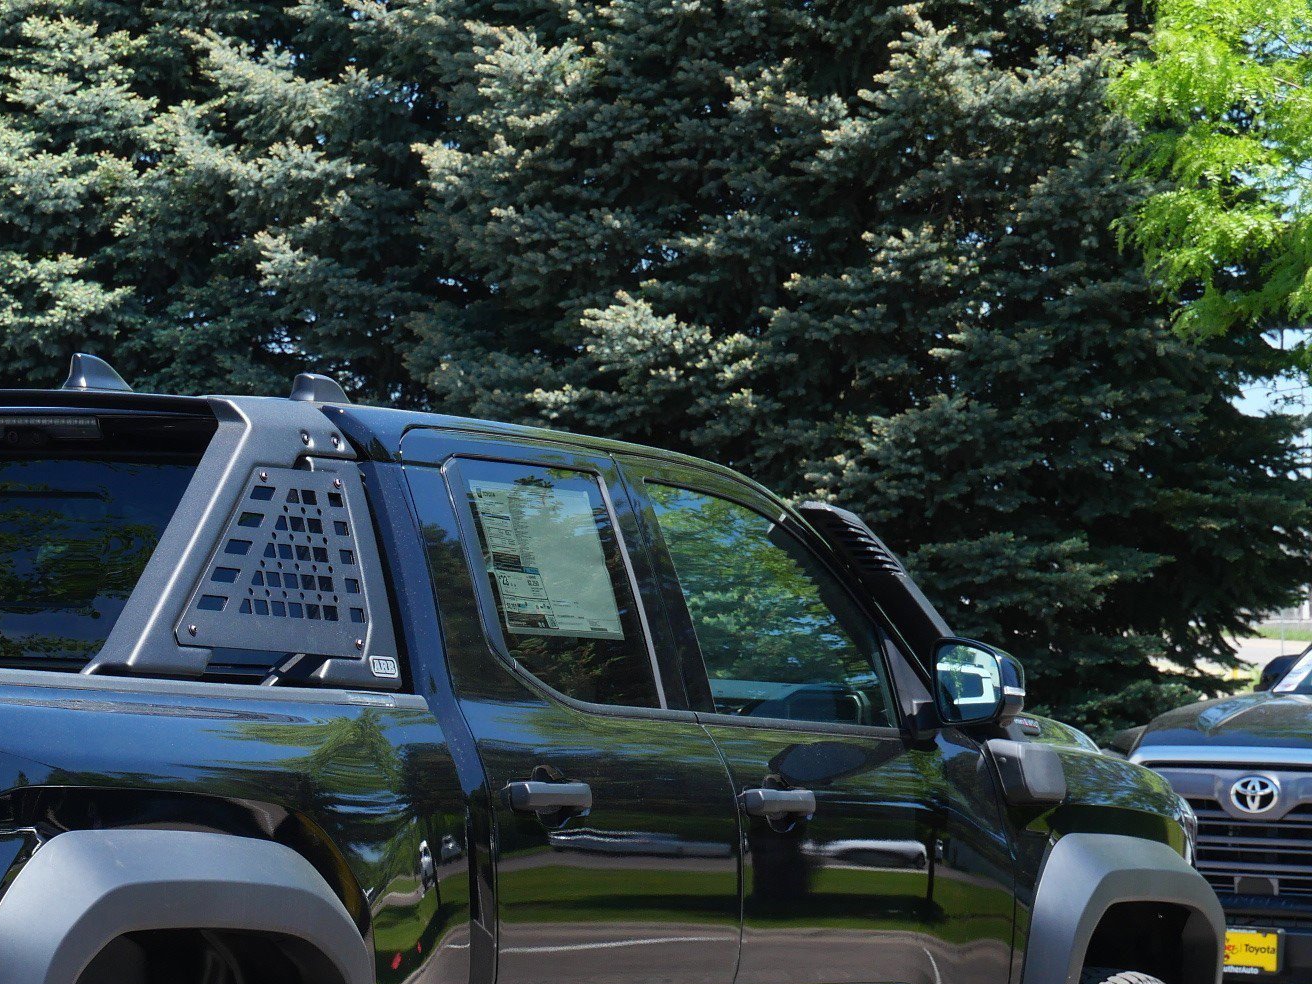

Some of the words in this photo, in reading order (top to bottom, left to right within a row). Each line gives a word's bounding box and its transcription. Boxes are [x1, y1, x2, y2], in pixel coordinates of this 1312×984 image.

[374, 659, 396, 674] ARB
[1244, 943, 1276, 955] Toyota
[1223, 965, 1259, 975] utherAuto
